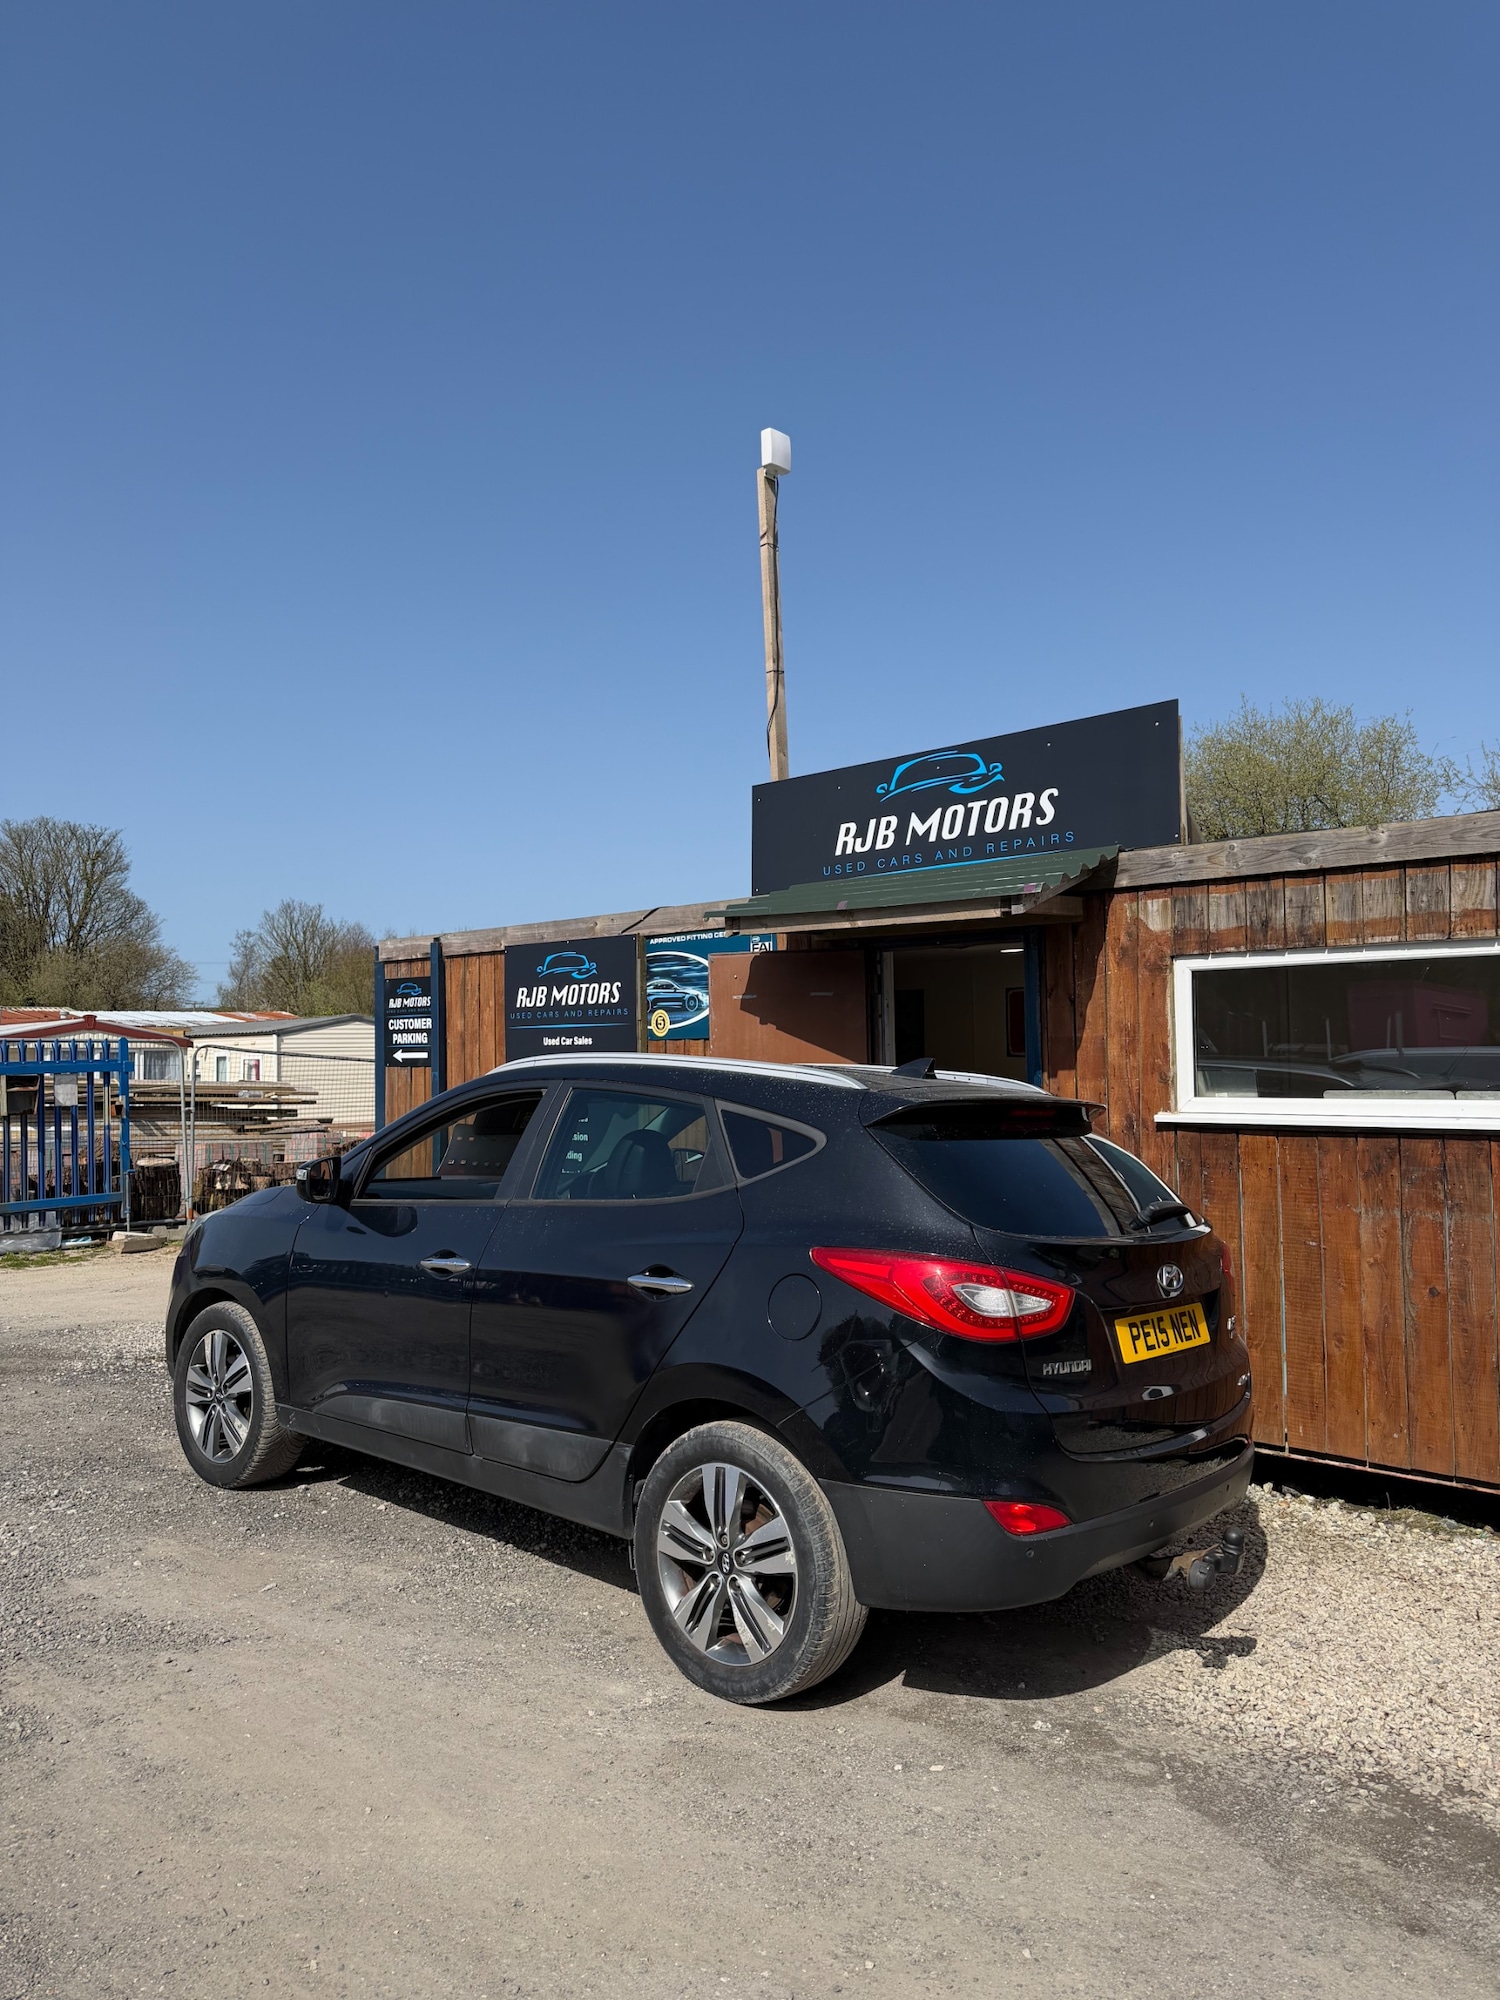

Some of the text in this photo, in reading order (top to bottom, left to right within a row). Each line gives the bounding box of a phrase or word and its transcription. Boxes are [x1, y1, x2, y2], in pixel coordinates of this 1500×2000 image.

[835, 787, 1059, 856] RJB MOTORS
[823, 831, 1075, 876] USED CARS AND REPAIRS
[649, 935, 686, 945] APPROVED
[686, 932, 713, 941] FITTING
[516, 981, 622, 1008] RJB MOTORS
[388, 996, 431, 1008] RJB MOTORS
[510, 1012, 532, 1020] USED
[564, 1010, 583, 1018] AND
[588, 1008, 629, 1017] REPAIRS
[388, 1018, 432, 1030] CUSTOMER
[656, 1016, 665, 1030] 5
[392, 1032, 428, 1044] PARKING
[543, 1036, 593, 1046] Used Car Sales
[1128, 1316, 1170, 1354] PE15
[1169, 1309, 1201, 1344] NEN
[1042, 1358, 1092, 1376] HYUNDAI
